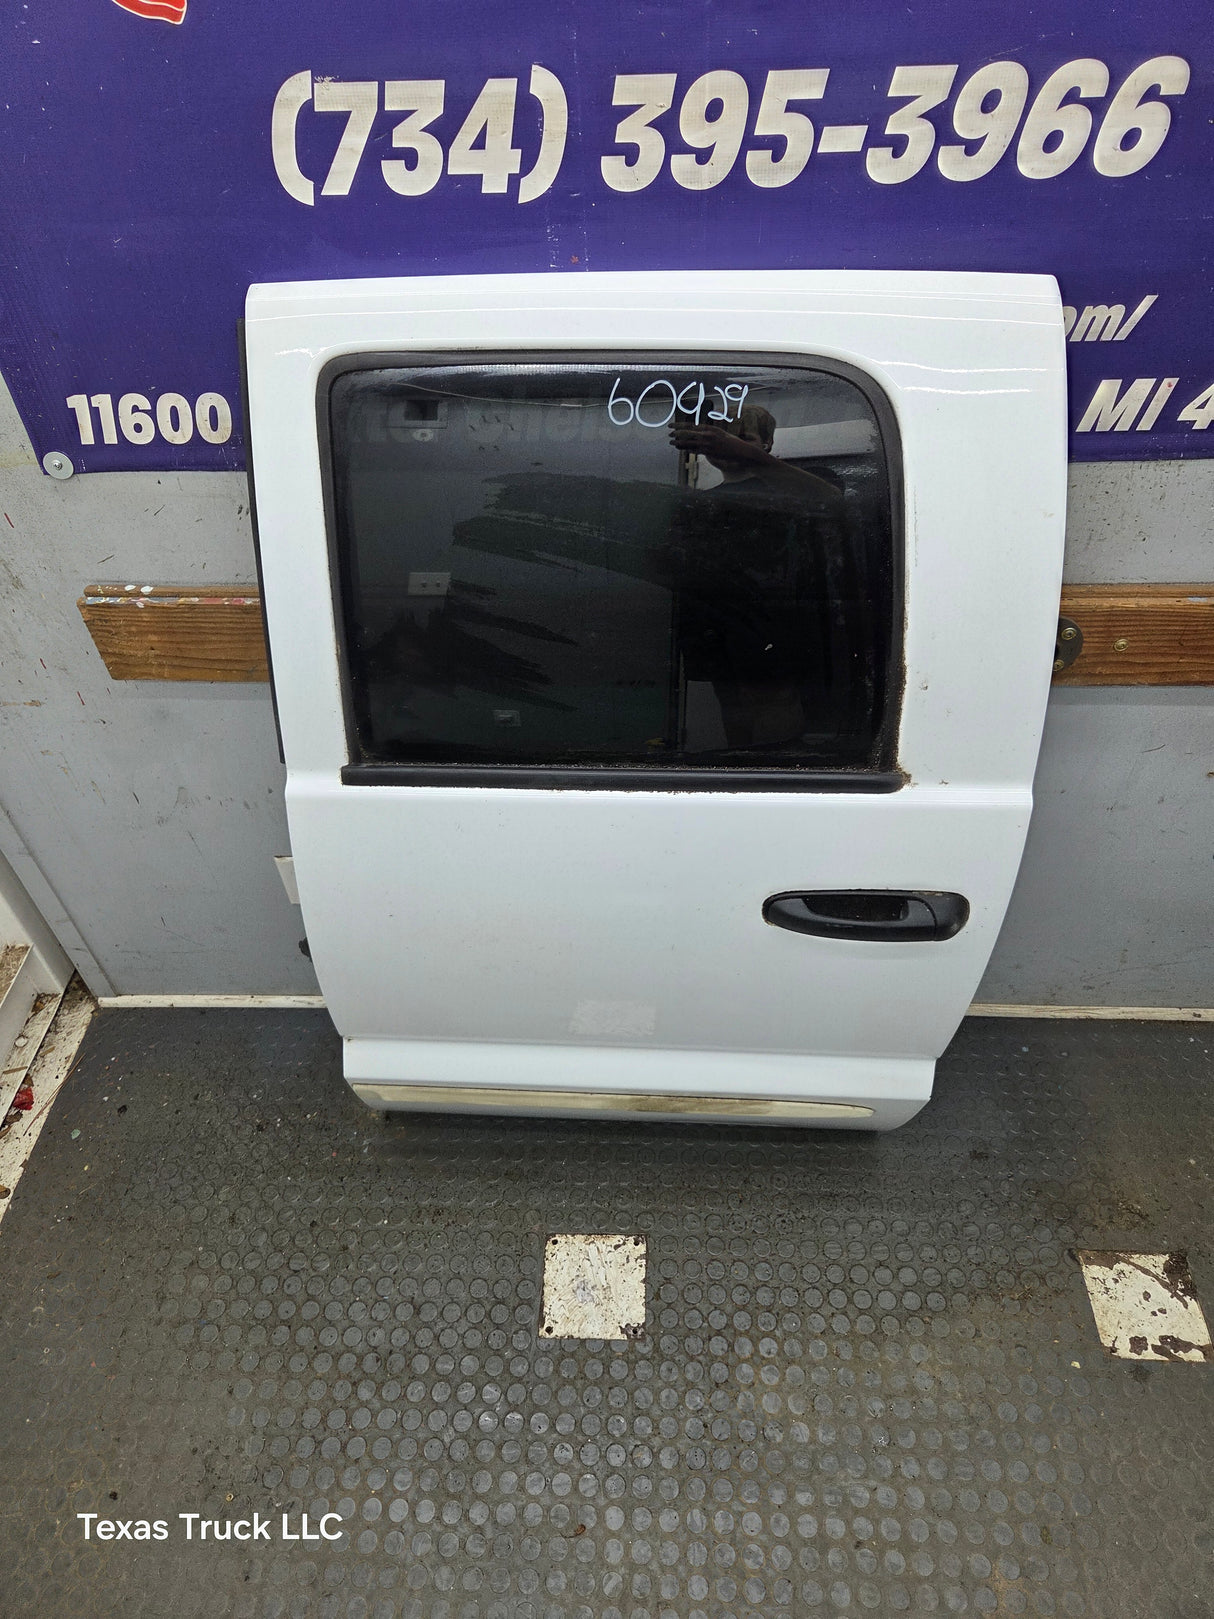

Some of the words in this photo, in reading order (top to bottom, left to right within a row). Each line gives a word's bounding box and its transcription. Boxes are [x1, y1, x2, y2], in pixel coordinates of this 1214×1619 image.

[272, 65, 568, 206] (734)
[601, 56, 1190, 192] 395-3966
[66, 393, 232, 444] 11600
[1076, 378, 1179, 432] MI
